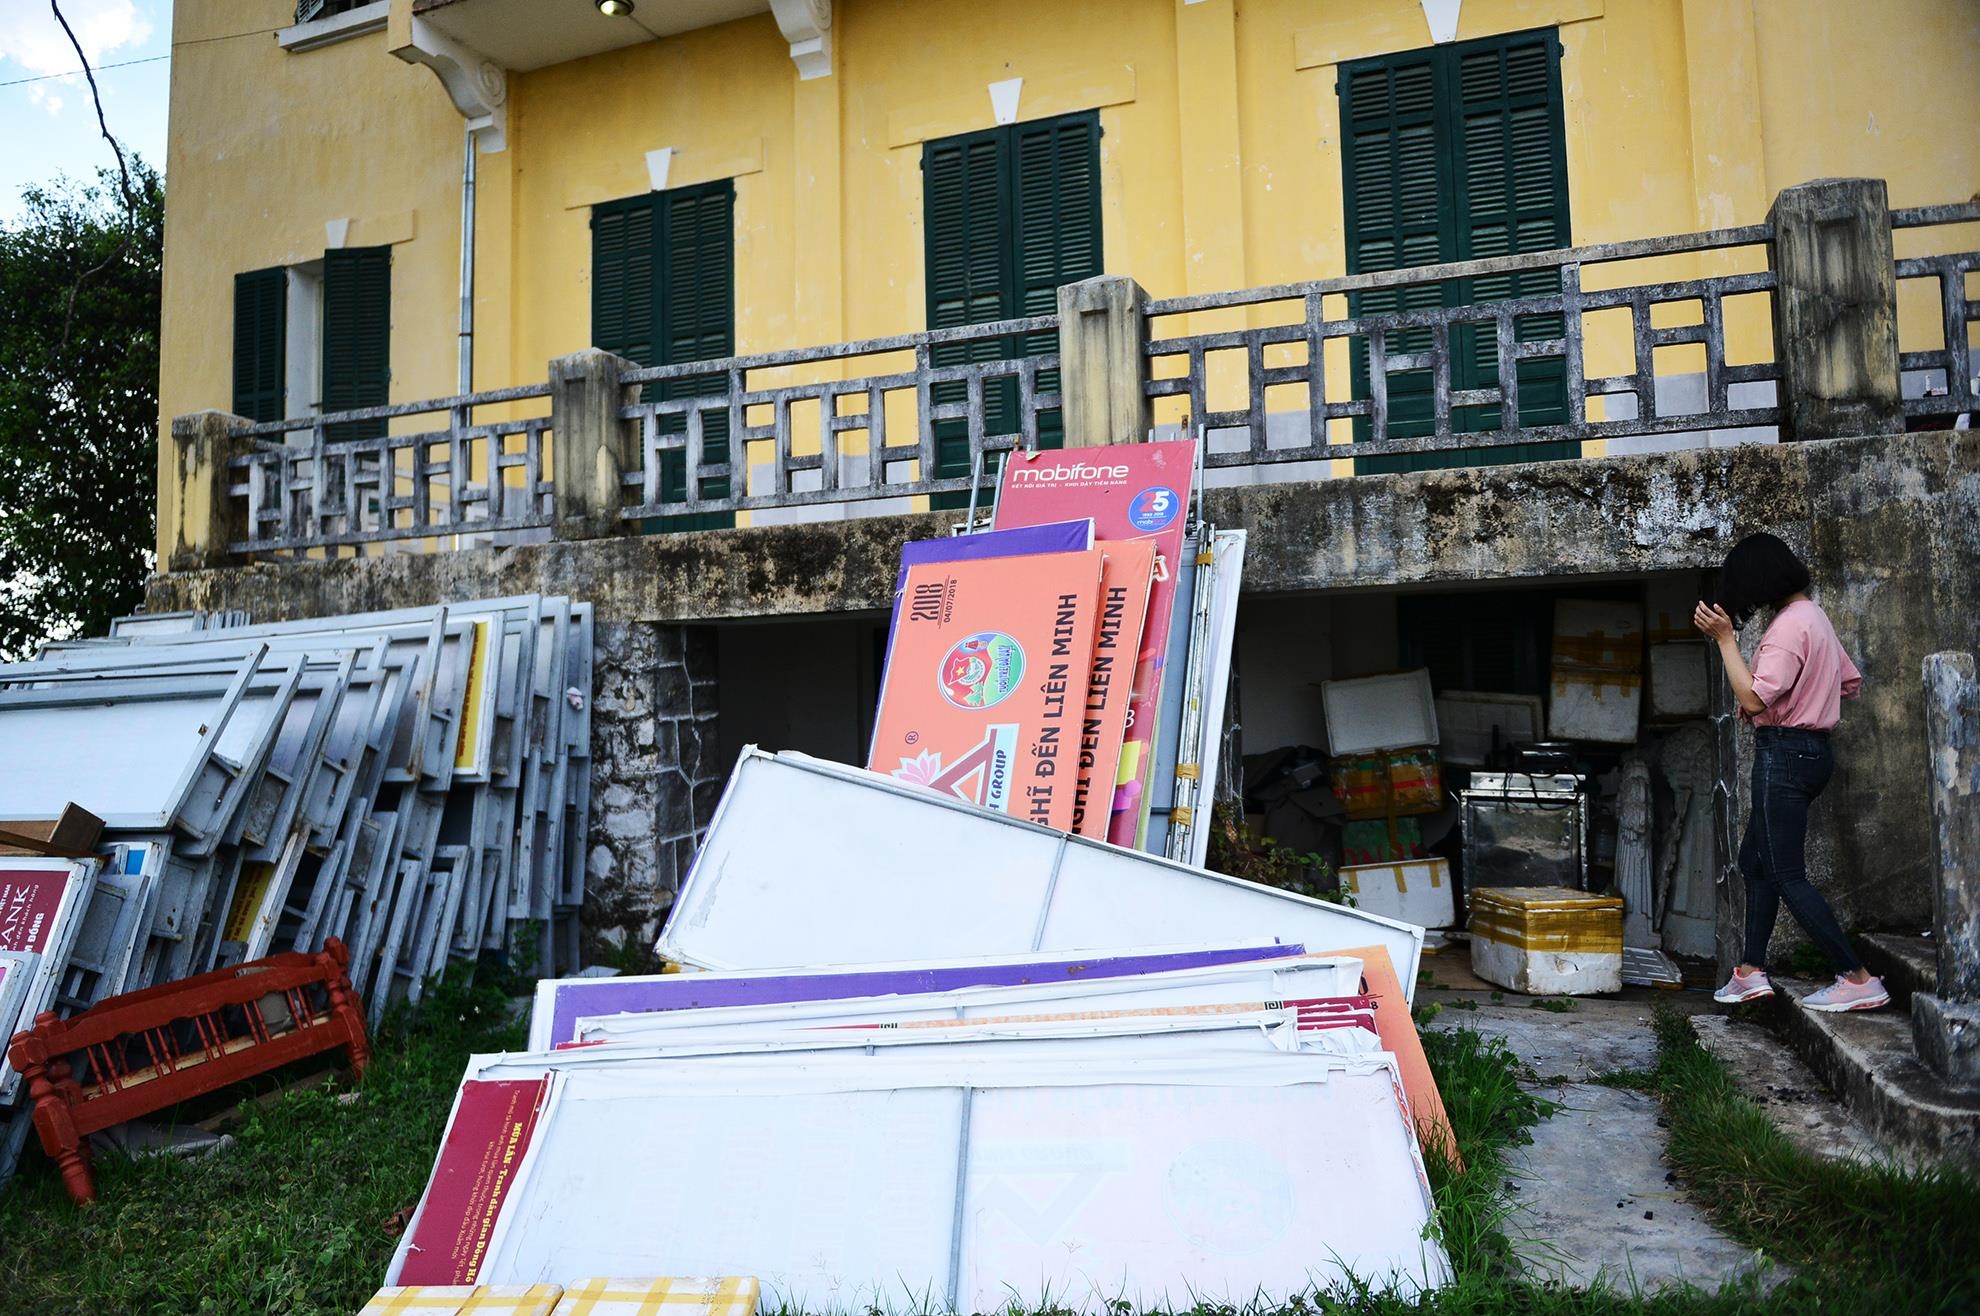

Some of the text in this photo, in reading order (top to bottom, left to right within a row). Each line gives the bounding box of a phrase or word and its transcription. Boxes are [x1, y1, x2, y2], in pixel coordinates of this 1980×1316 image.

[1012, 462, 1129, 482] mobifone
[910, 583, 944, 621] 2018
[944, 579, 957, 623] 04/07/2018
[1098, 587, 1128, 649] MINH
[1051, 594, 1078, 657] MINH
[1040, 663, 1070, 719] LIÊN
[991, 749, 1007, 799] GROUP
[1032, 727, 1061, 778] ĐẾN
[493, 1169, 508, 1197] Tranh
[479, 1218, 490, 1239] gian
